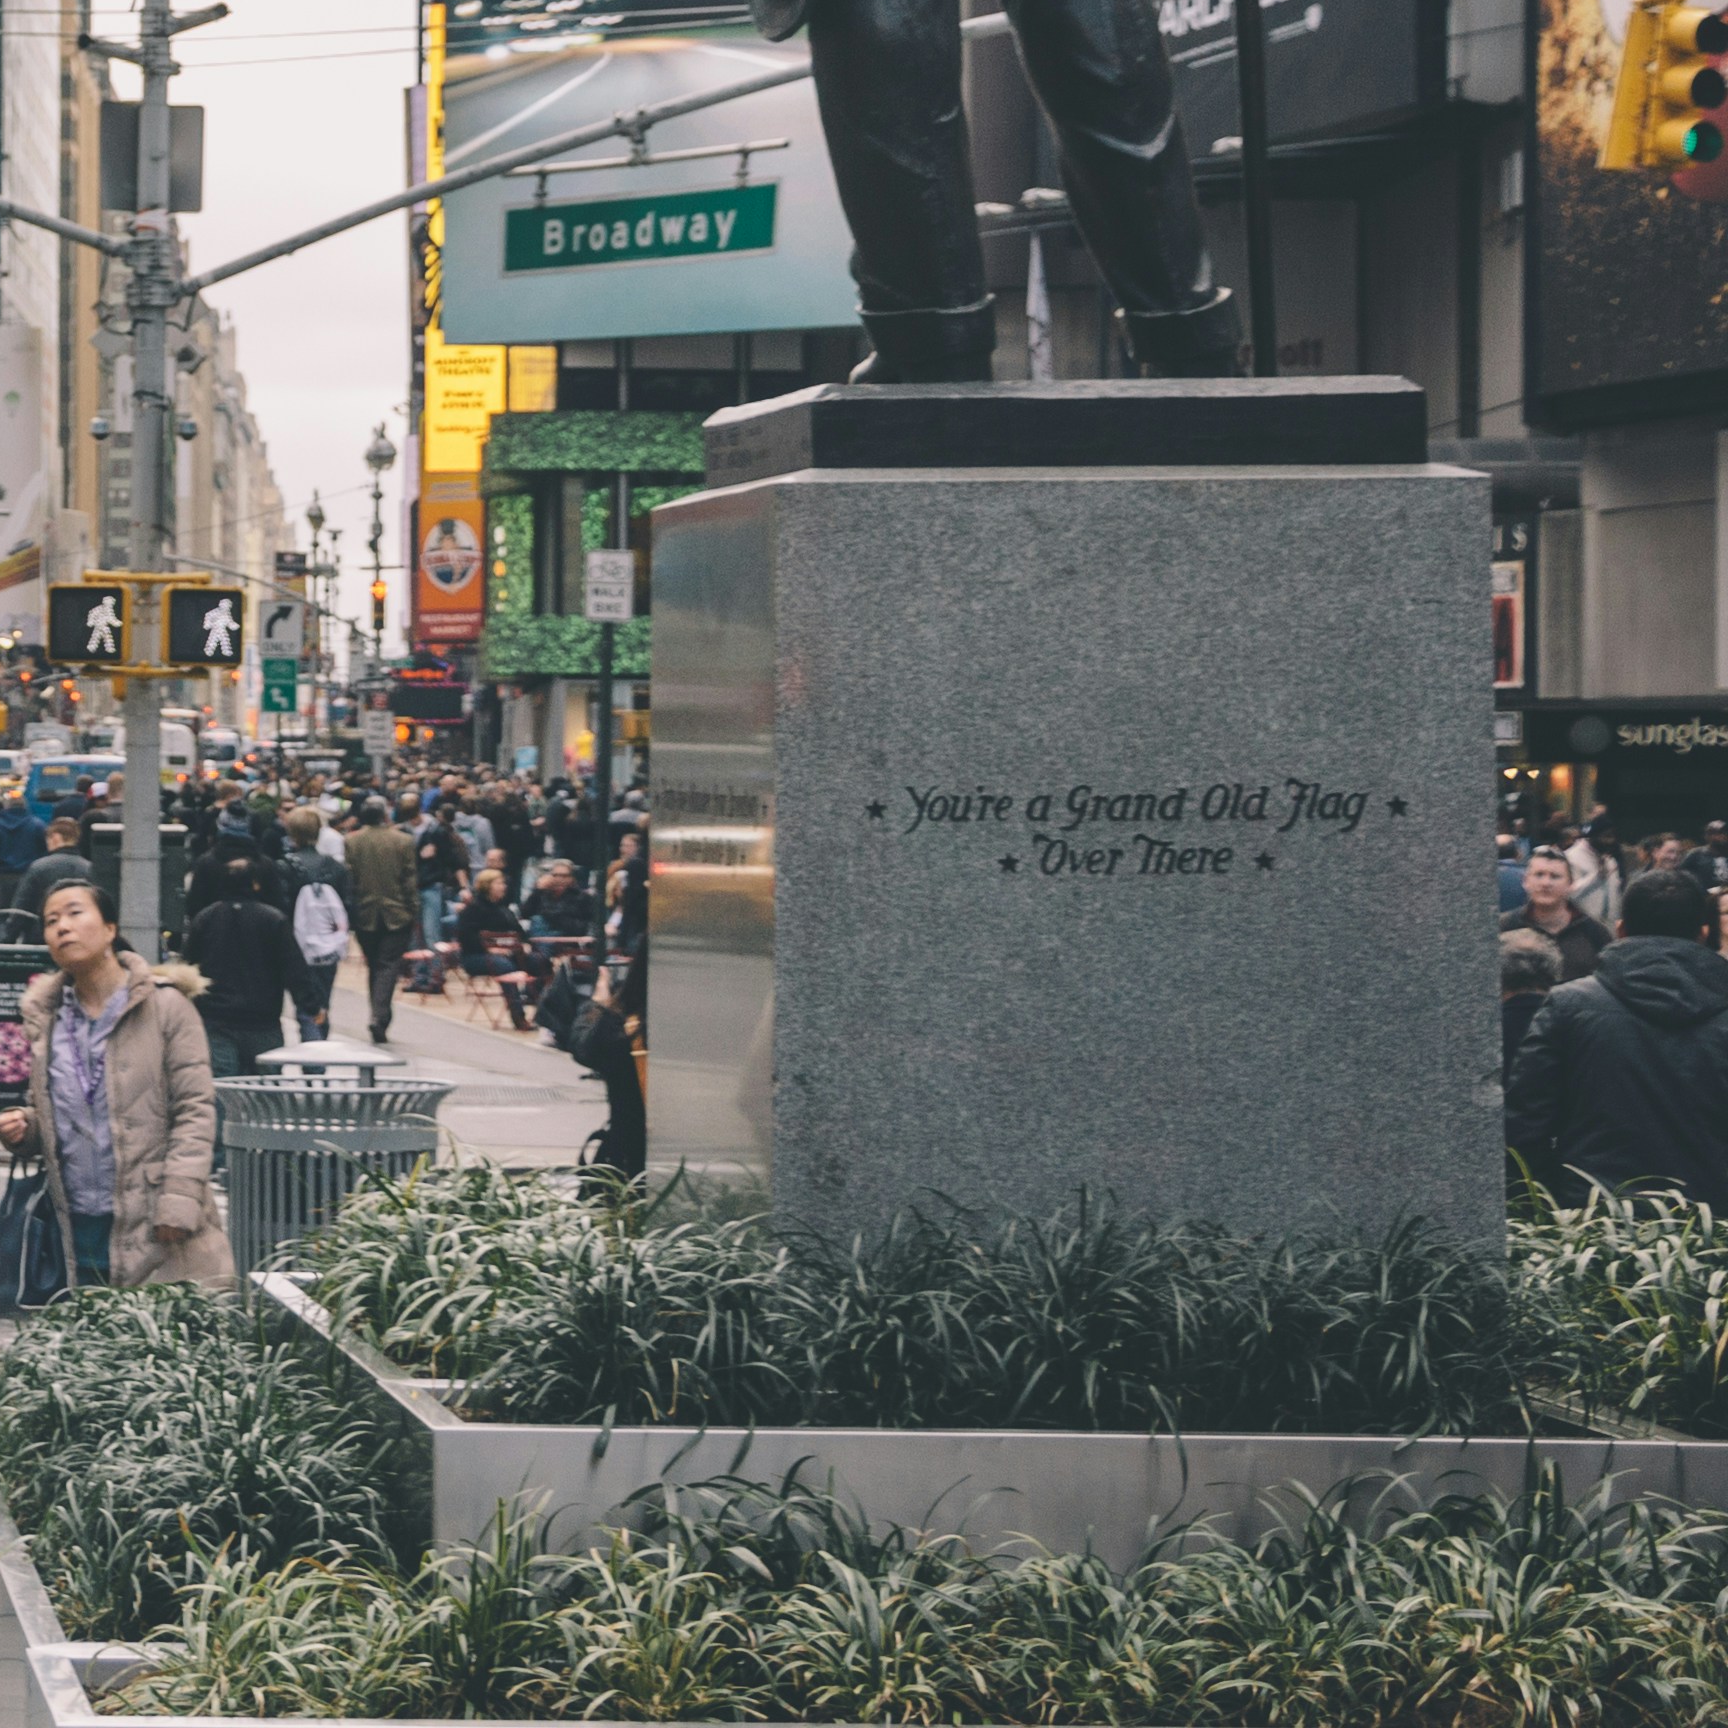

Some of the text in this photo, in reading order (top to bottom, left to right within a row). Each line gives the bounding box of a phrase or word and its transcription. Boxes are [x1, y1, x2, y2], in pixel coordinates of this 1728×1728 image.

[543, 209, 737, 256] Broadway
[904, 777, 1370, 835] You're a Grand Old Flag
[1032, 832, 1235, 876] Over There
